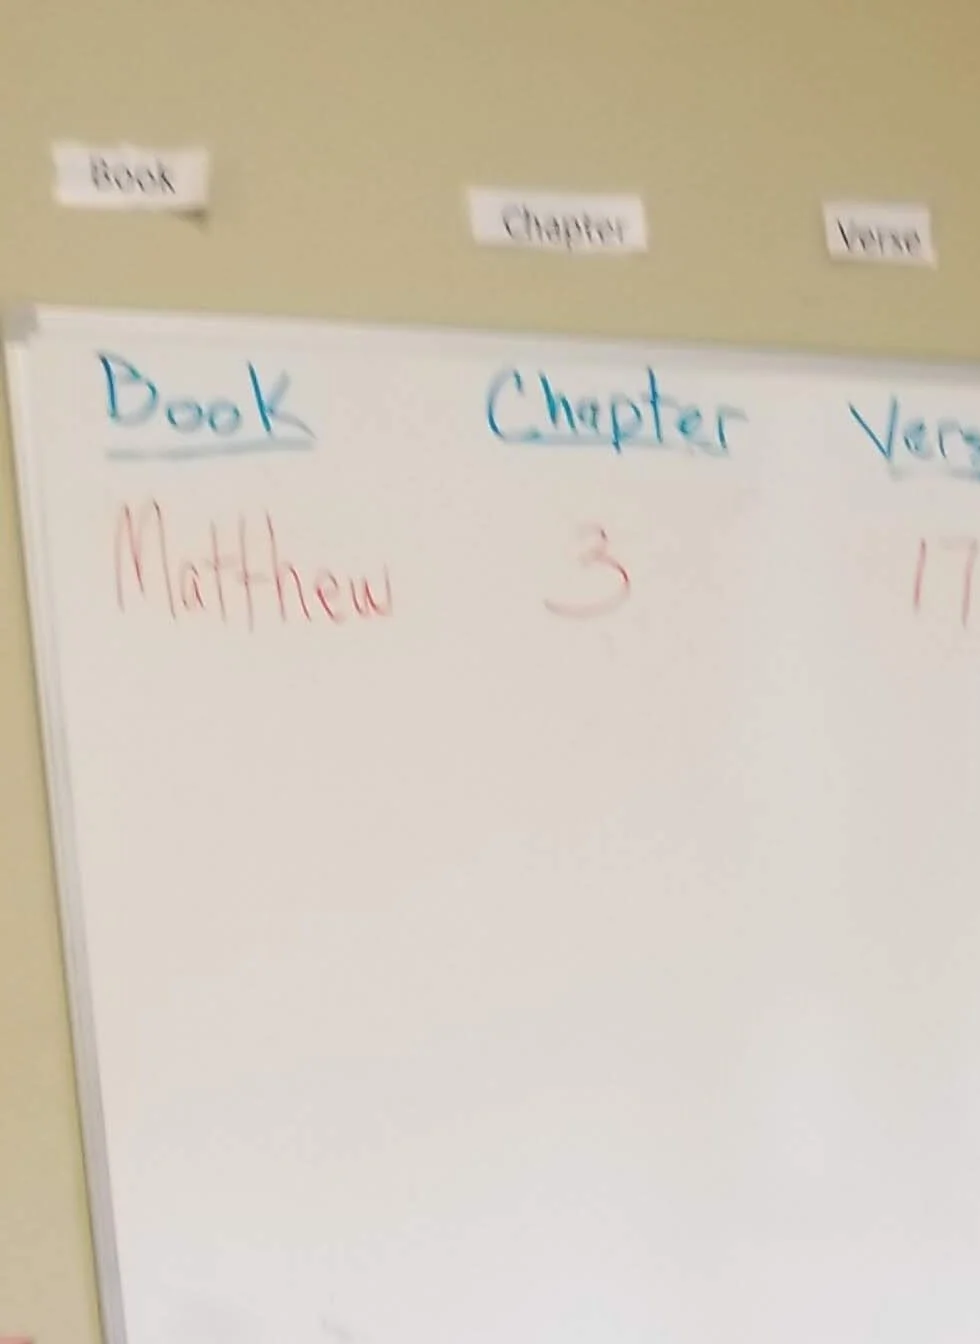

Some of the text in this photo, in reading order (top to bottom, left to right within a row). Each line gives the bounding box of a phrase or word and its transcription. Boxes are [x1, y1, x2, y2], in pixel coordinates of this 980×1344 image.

[91, 153, 177, 196] Book
[501, 202, 626, 252] Chapter
[836, 216, 923, 256] Verse
[97, 349, 318, 435] Book
[486, 363, 746, 454] Chapter
[113, 497, 978, 633] Matthew 3 17
